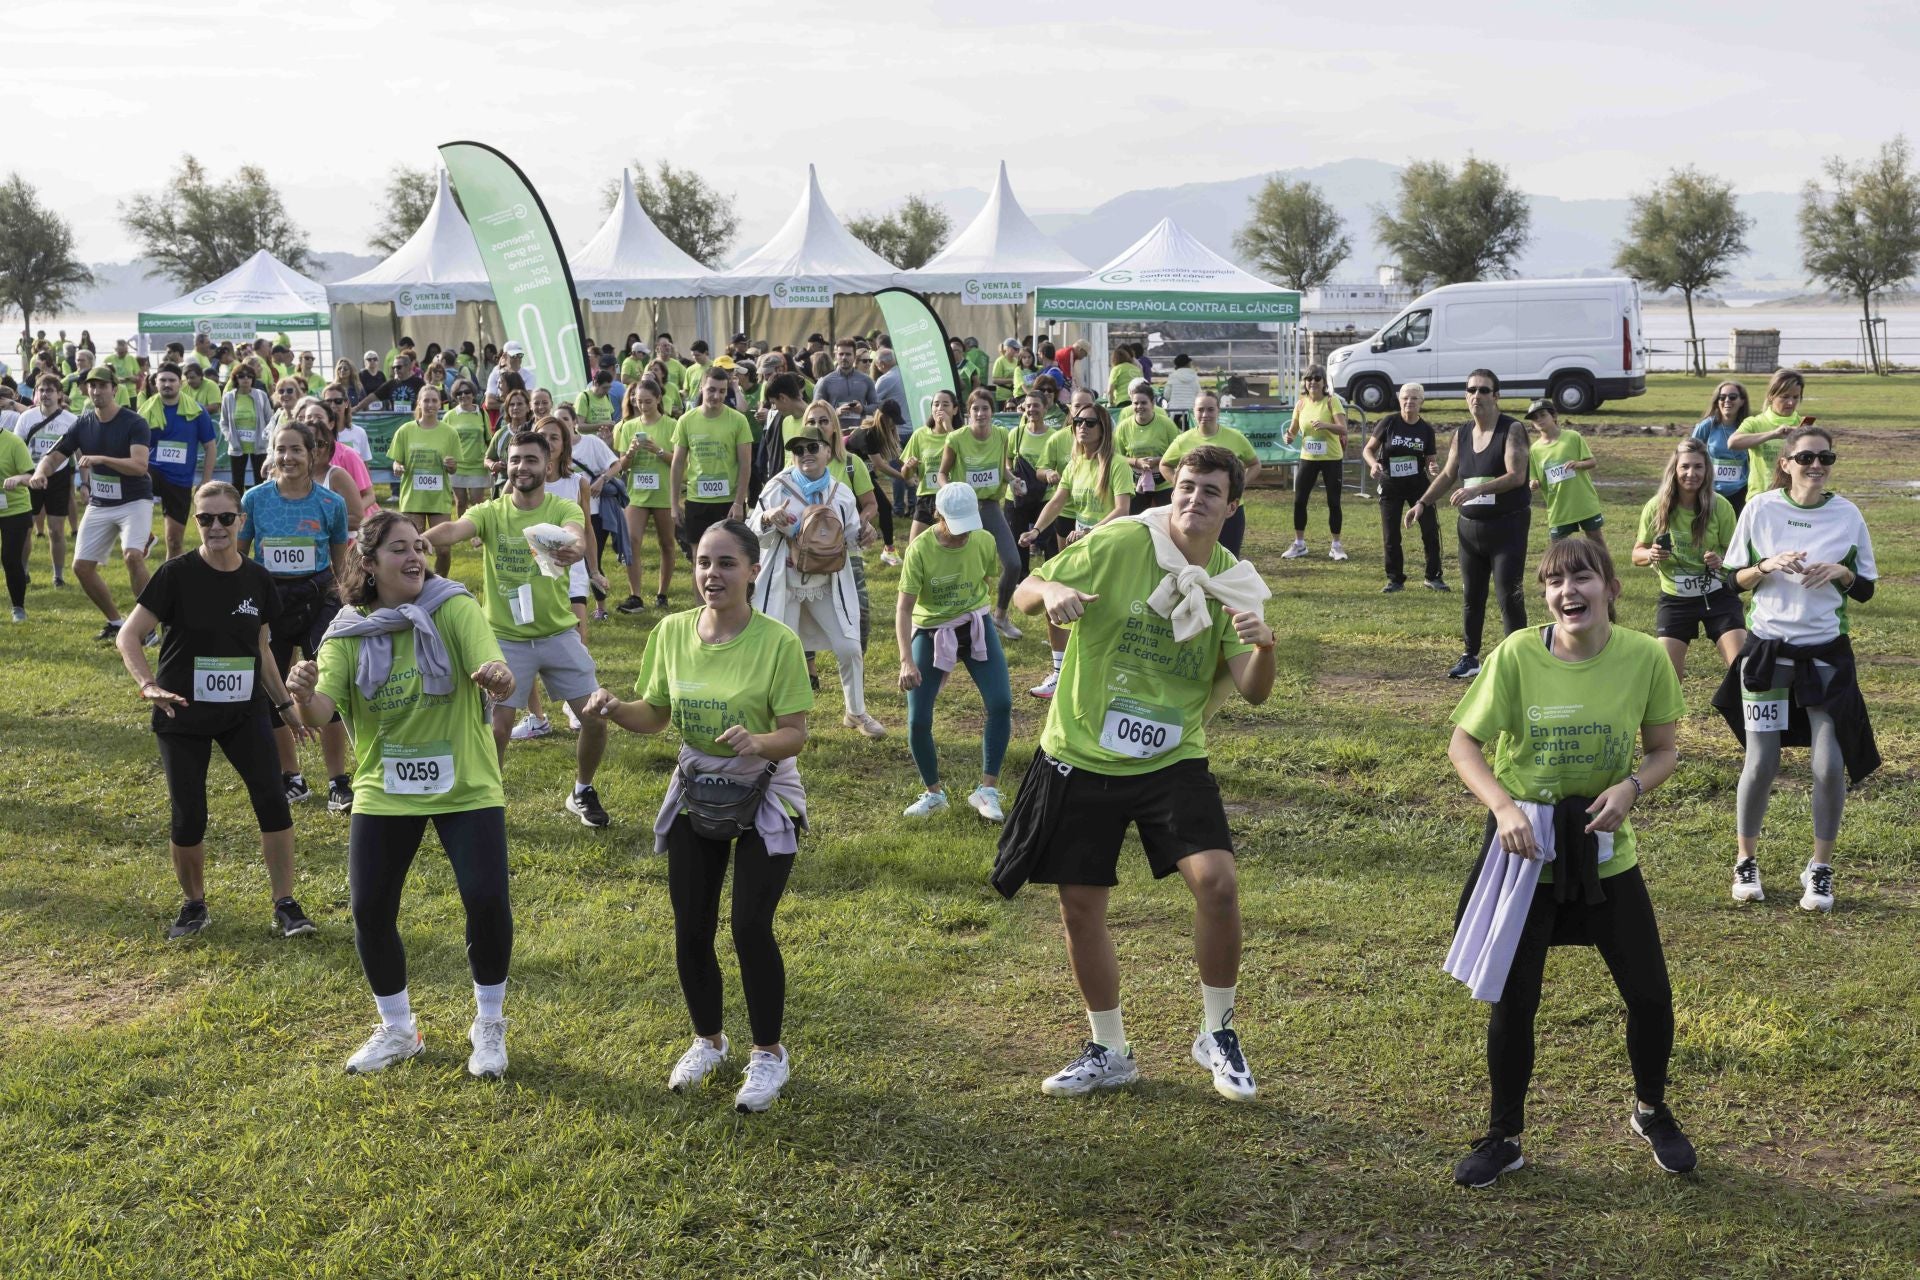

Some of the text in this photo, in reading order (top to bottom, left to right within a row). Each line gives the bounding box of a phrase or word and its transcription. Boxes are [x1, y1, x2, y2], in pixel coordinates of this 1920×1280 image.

[790, 285, 816, 293] VENTA
[415, 292, 451, 301] VENTA DE
[788, 295, 830, 303] DORSALES
[981, 292, 1024, 300] DORSALES
[413, 302, 455, 311] CAMISETAS
[1042, 298, 1294, 314] ASOCIACIÓN ESPAÑOLA CONTRA EL CÁNCER
[143, 319, 192, 328] ASOCIACIÓN
[212, 322, 252, 330] RECOGIDA DE
[210, 332, 241, 340] DORSALES
[1244, 431, 1277, 440] cáncer
[40, 440, 57, 449] 012
[1307, 442, 1322, 450] 0179
[162, 447, 181, 458] 0272
[1395, 462, 1412, 473] 0184
[1717, 467, 1737, 477] 0076
[418, 476, 437, 485] 0064
[637, 475, 654, 485] 0065
[972, 472, 993, 483] 0024
[96, 482, 114, 494] 0201
[703, 482, 723, 491] 0020
[498, 544, 508, 553] En
[274, 549, 305, 563] 0160
[496, 554, 525, 564] contra
[1126, 617, 1174, 639] En marc
[1118, 643, 1130, 654] el
[389, 667, 421, 683] arch
[206, 674, 242, 692] 0601
[372, 686, 404, 700] ontra
[381, 694, 420, 711] cánce
[678, 697, 728, 711] marcha
[1746, 704, 1778, 721] 0045
[1117, 718, 1166, 748] 0660
[1530, 721, 1612, 738] En marcha
[1532, 739, 1580, 751] contra
[1534, 753, 1600, 766] el cáncer
[395, 761, 440, 781] 0259
